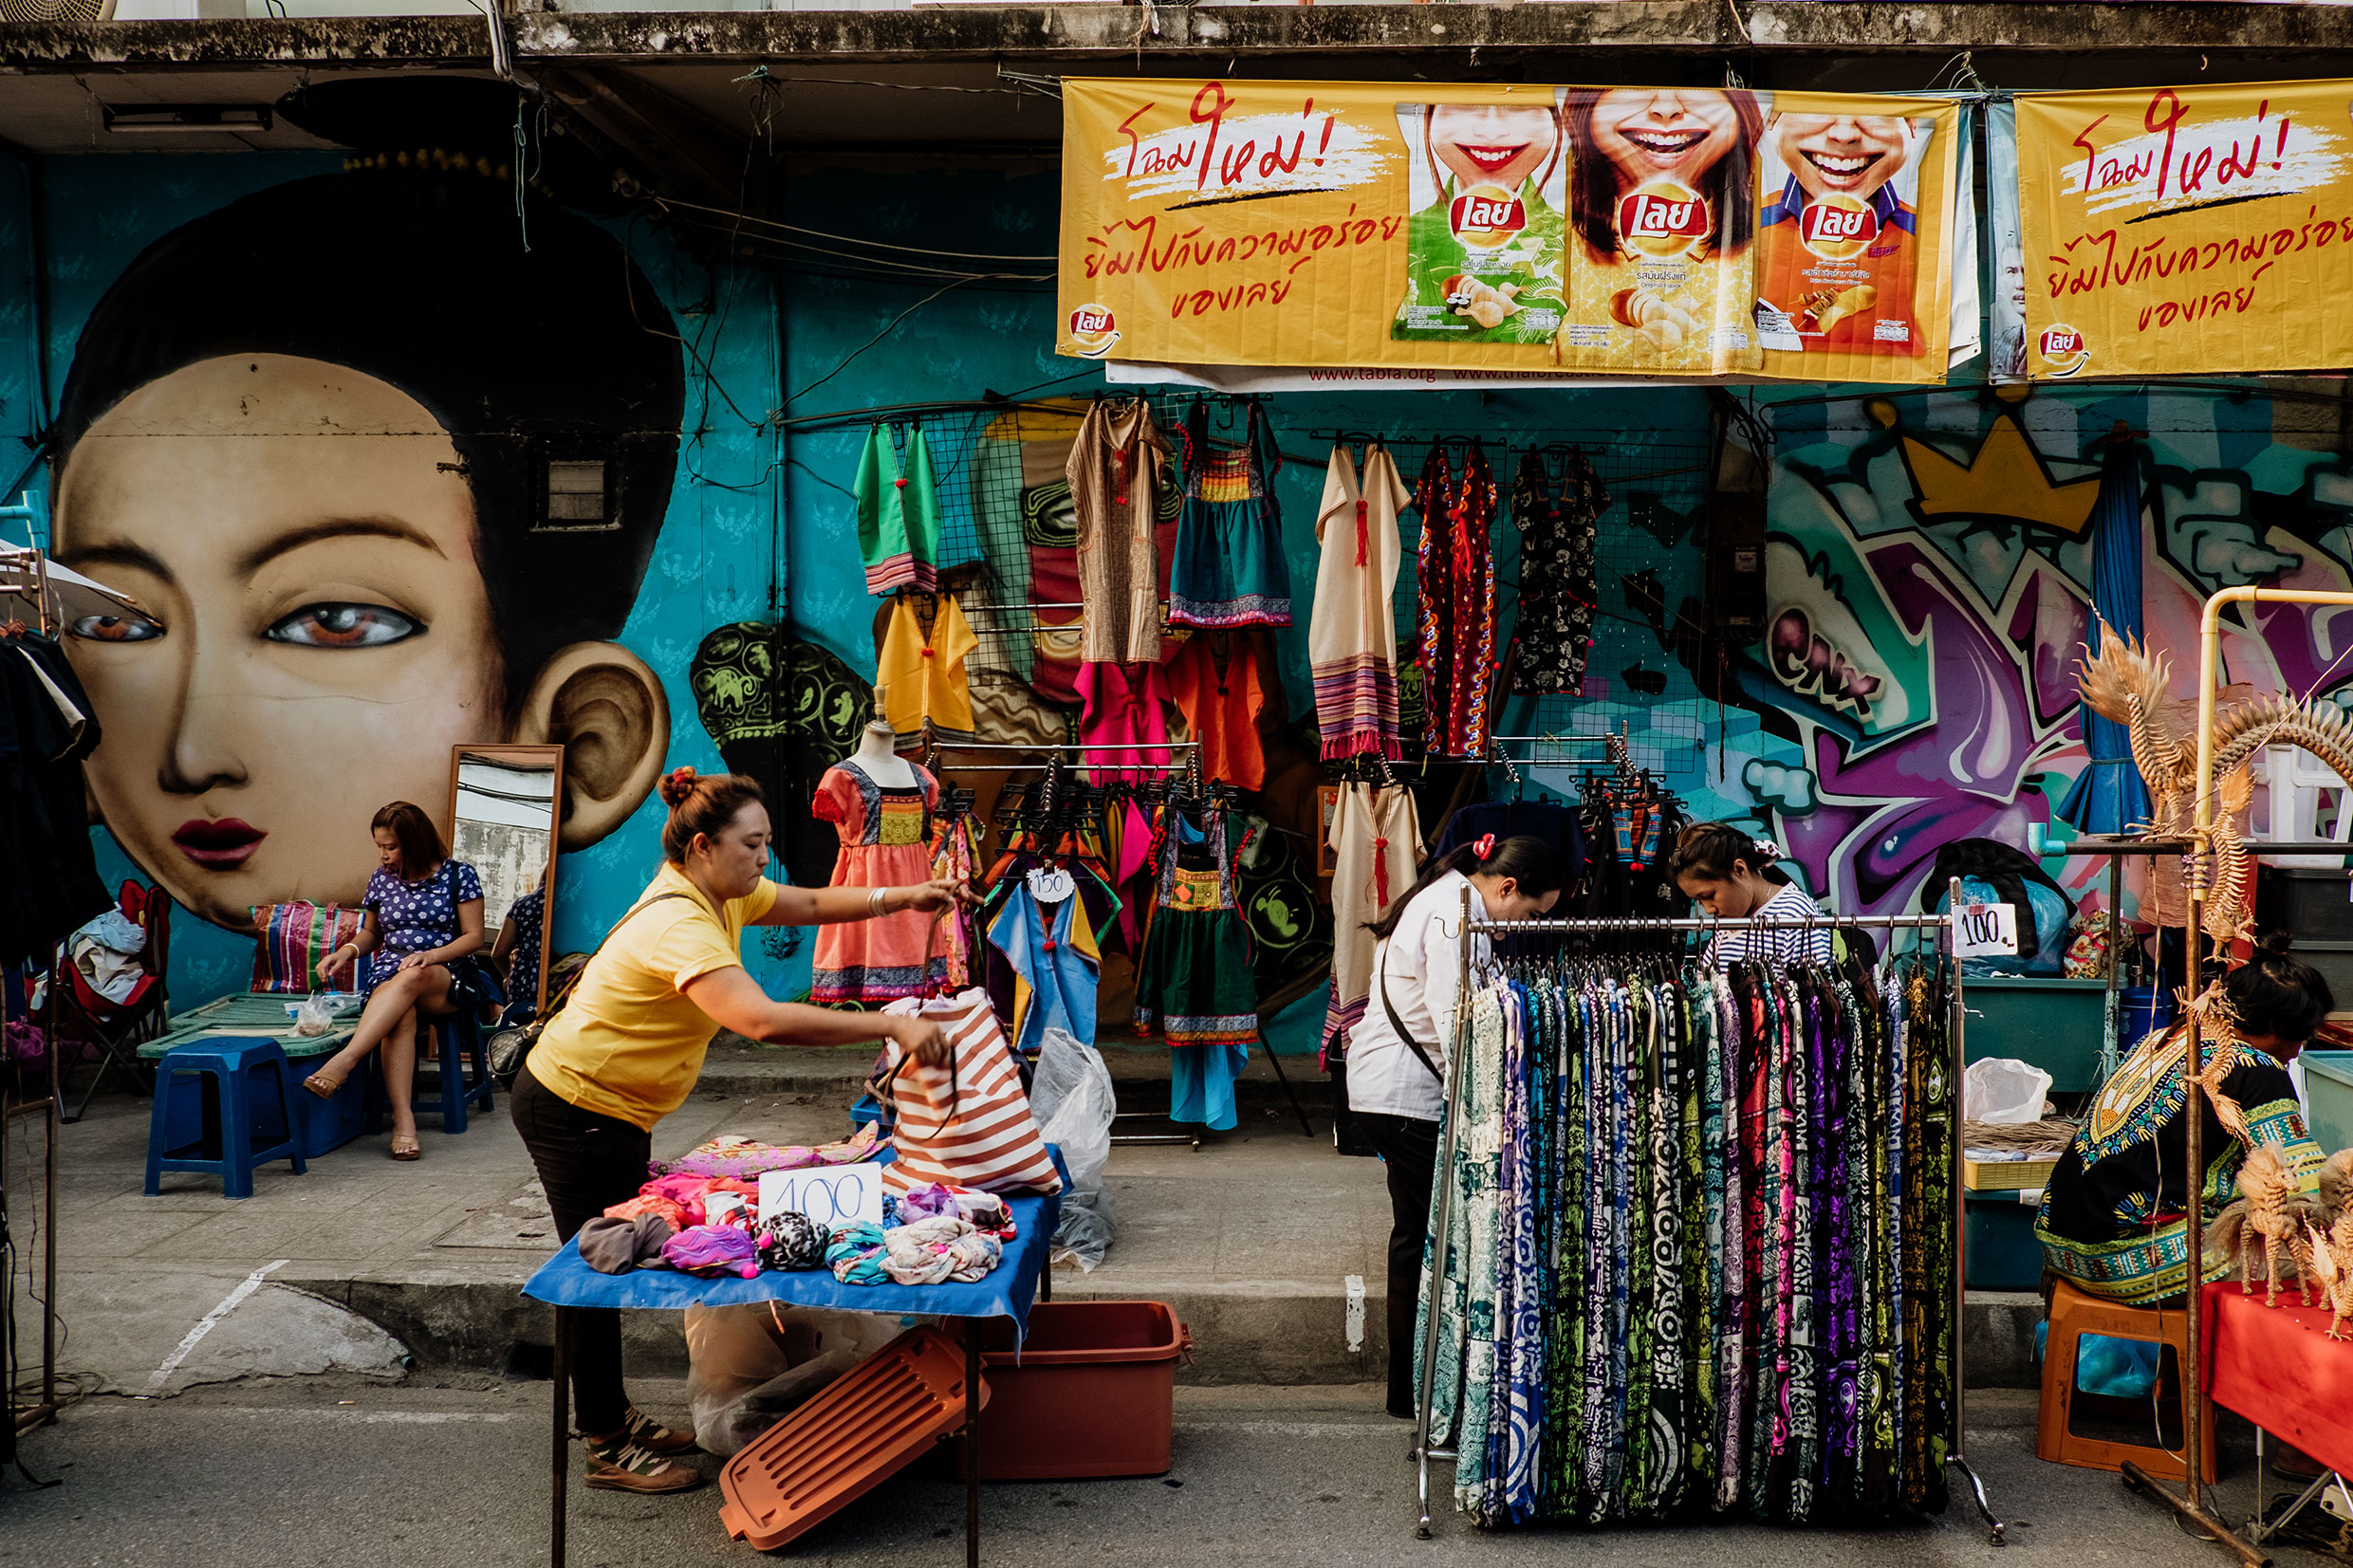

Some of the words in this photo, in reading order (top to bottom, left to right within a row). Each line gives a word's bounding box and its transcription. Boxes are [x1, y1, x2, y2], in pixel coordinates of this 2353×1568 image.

[1118, 82, 1335, 191] โฉมใหม่!
[2072, 88, 2290, 201] โฉมใหม่!
[1084, 203, 1402, 280] ยิ้มไปกับความอร่อย
[1171, 256, 1312, 319] ของเลย์
[2138, 261, 2274, 332] ของเลย์
[1033, 873, 1064, 894] 150
[774, 1173, 864, 1226] 100
